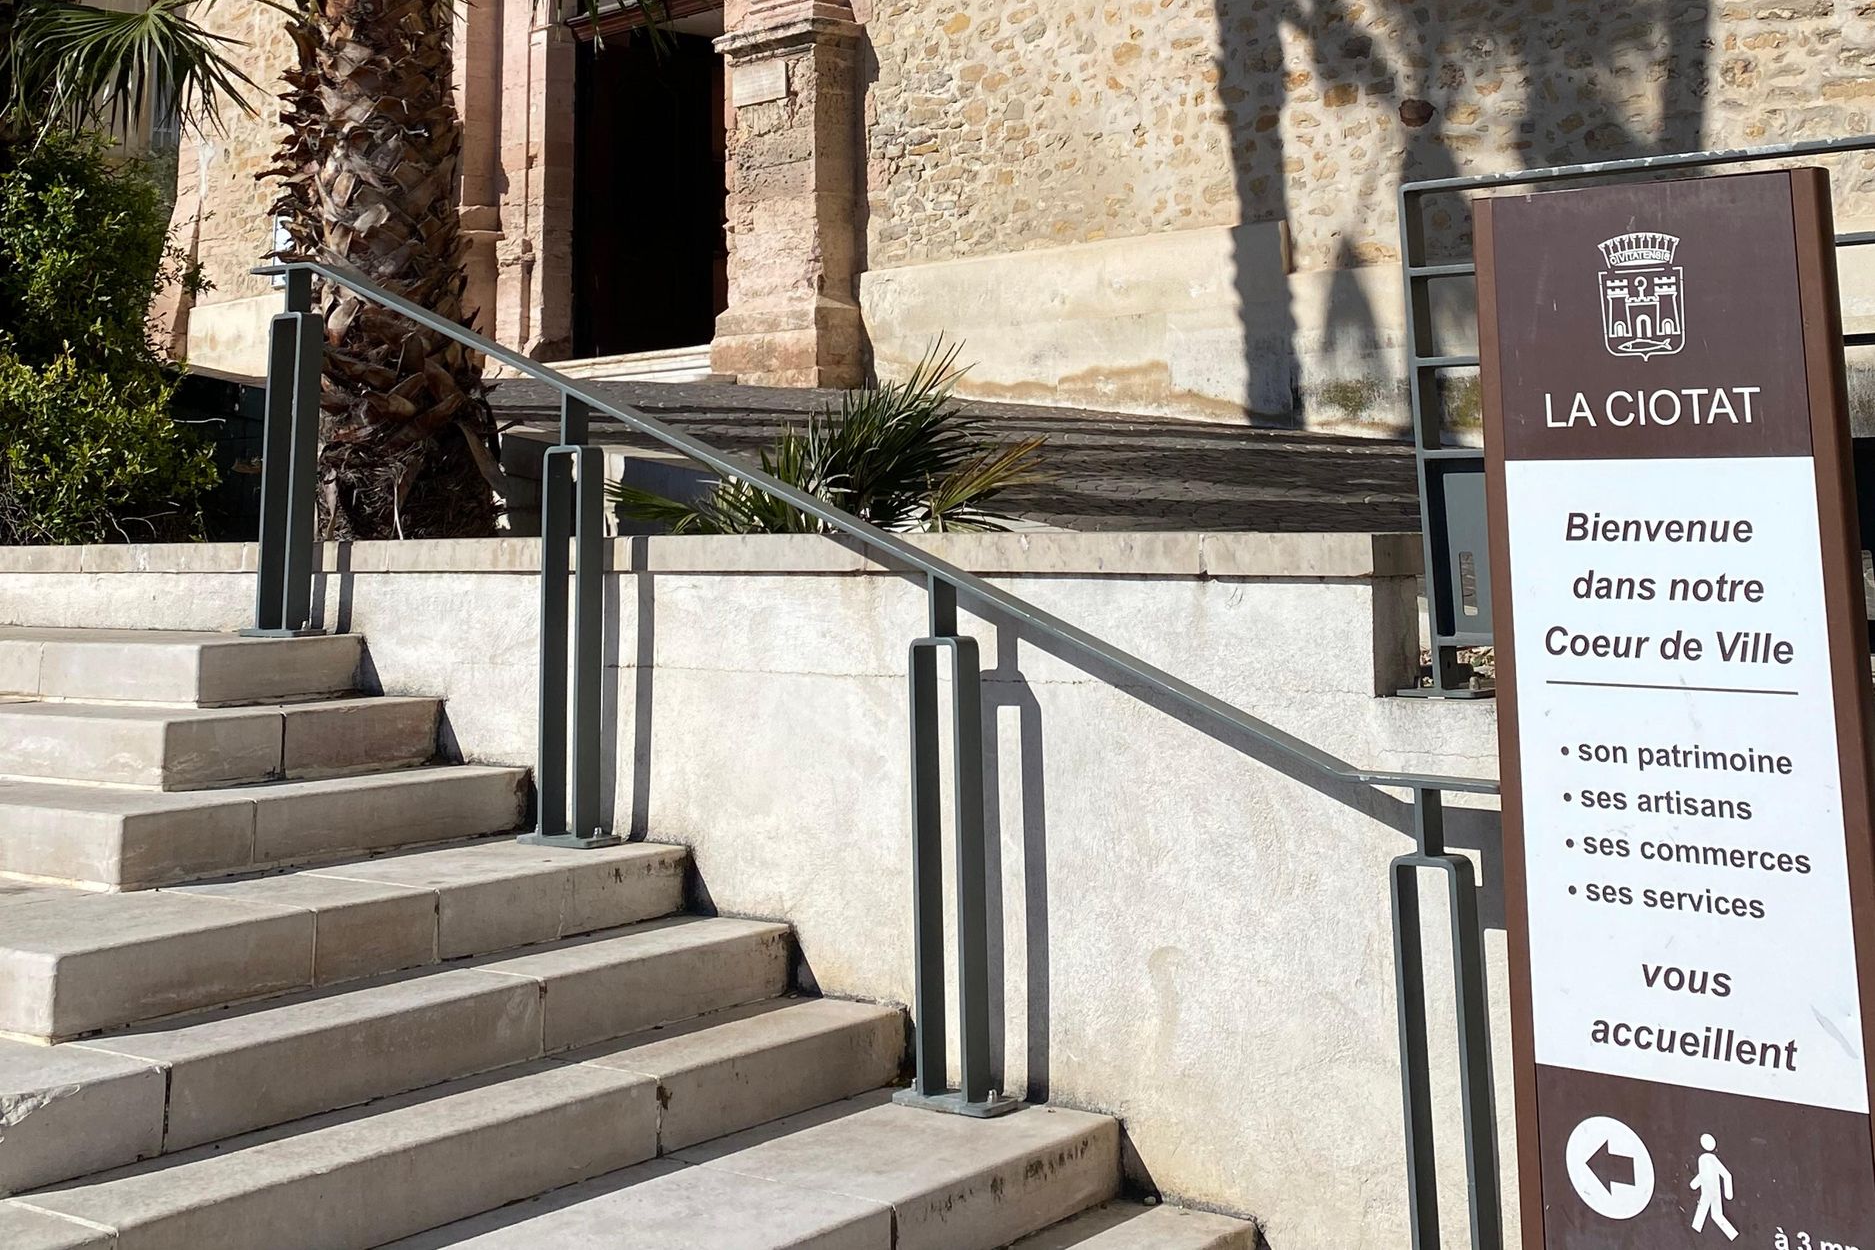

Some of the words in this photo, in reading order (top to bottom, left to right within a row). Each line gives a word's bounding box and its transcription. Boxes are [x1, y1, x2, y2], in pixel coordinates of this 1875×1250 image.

[1545, 393, 1596, 427] LA
[1606, 387, 1760, 426] CIOTAT
[1566, 513, 1752, 542] Bienvenue
[1573, 570, 1655, 600] dans
[1670, 574, 1763, 602] notre
[1546, 626, 1649, 658] Coeur
[1660, 631, 1702, 660] de
[1717, 632, 1793, 664] Ville
[1579, 744, 1627, 763] son
[1639, 745, 1792, 774] patrimoine
[1581, 790, 1627, 810] ses
[1638, 791, 1751, 819] artisans
[1584, 837, 1630, 857] ses
[1641, 842, 1810, 873] commerces
[1587, 884, 1632, 904] ses
[1644, 889, 1764, 918] services
[1642, 964, 1731, 997] vous
[1591, 1020, 1797, 1072] accueillent
